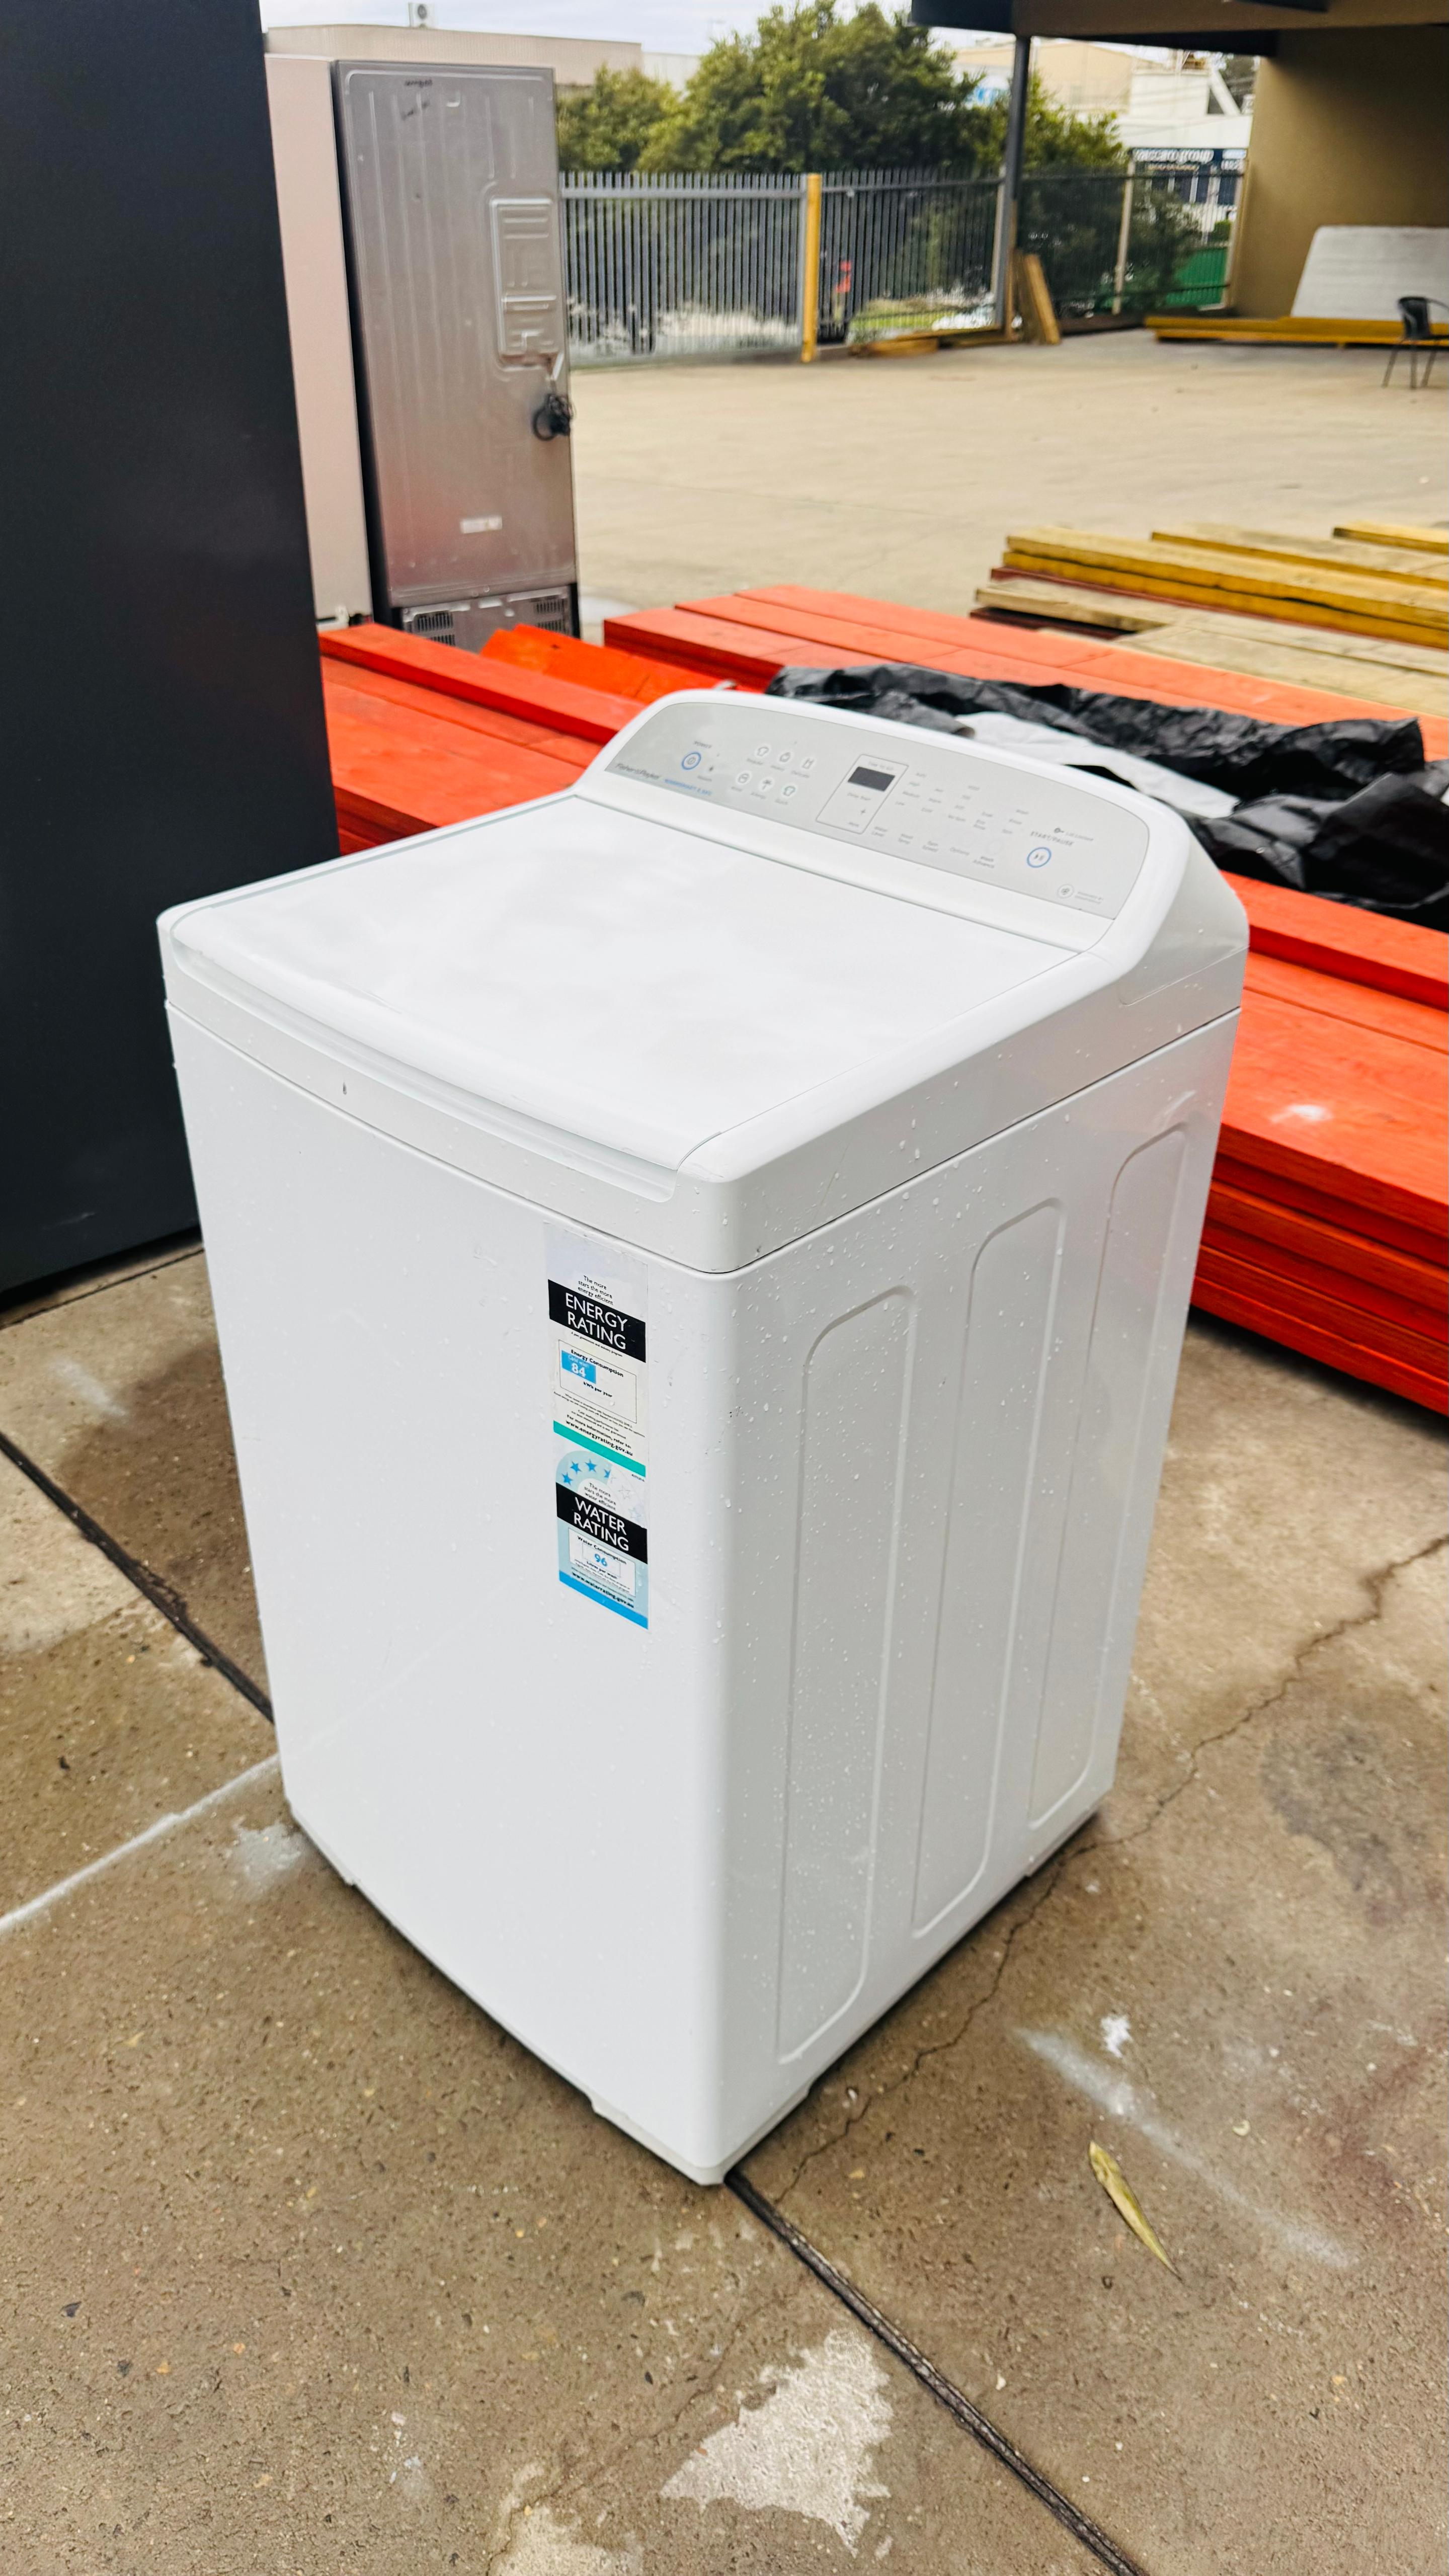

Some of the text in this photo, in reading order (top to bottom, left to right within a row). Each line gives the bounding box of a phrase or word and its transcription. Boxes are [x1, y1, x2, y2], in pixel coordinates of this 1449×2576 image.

[578, 1287, 613, 1305] energy efficient
[583, 1275, 607, 1290] The more
[566, 1293, 628, 1331] ENERGY
[568, 1311, 626, 1349] RATING
[571, 1349, 623, 1378] Energy Consumption
[571, 1363, 586, 1378] 84
[599, 1489, 611, 1497] more
[575, 1497, 627, 1535] WATER
[574, 1512, 628, 1551] RATING
[577, 1536, 626, 1564] Water Consumption
[595, 1554, 607, 1566] 96
